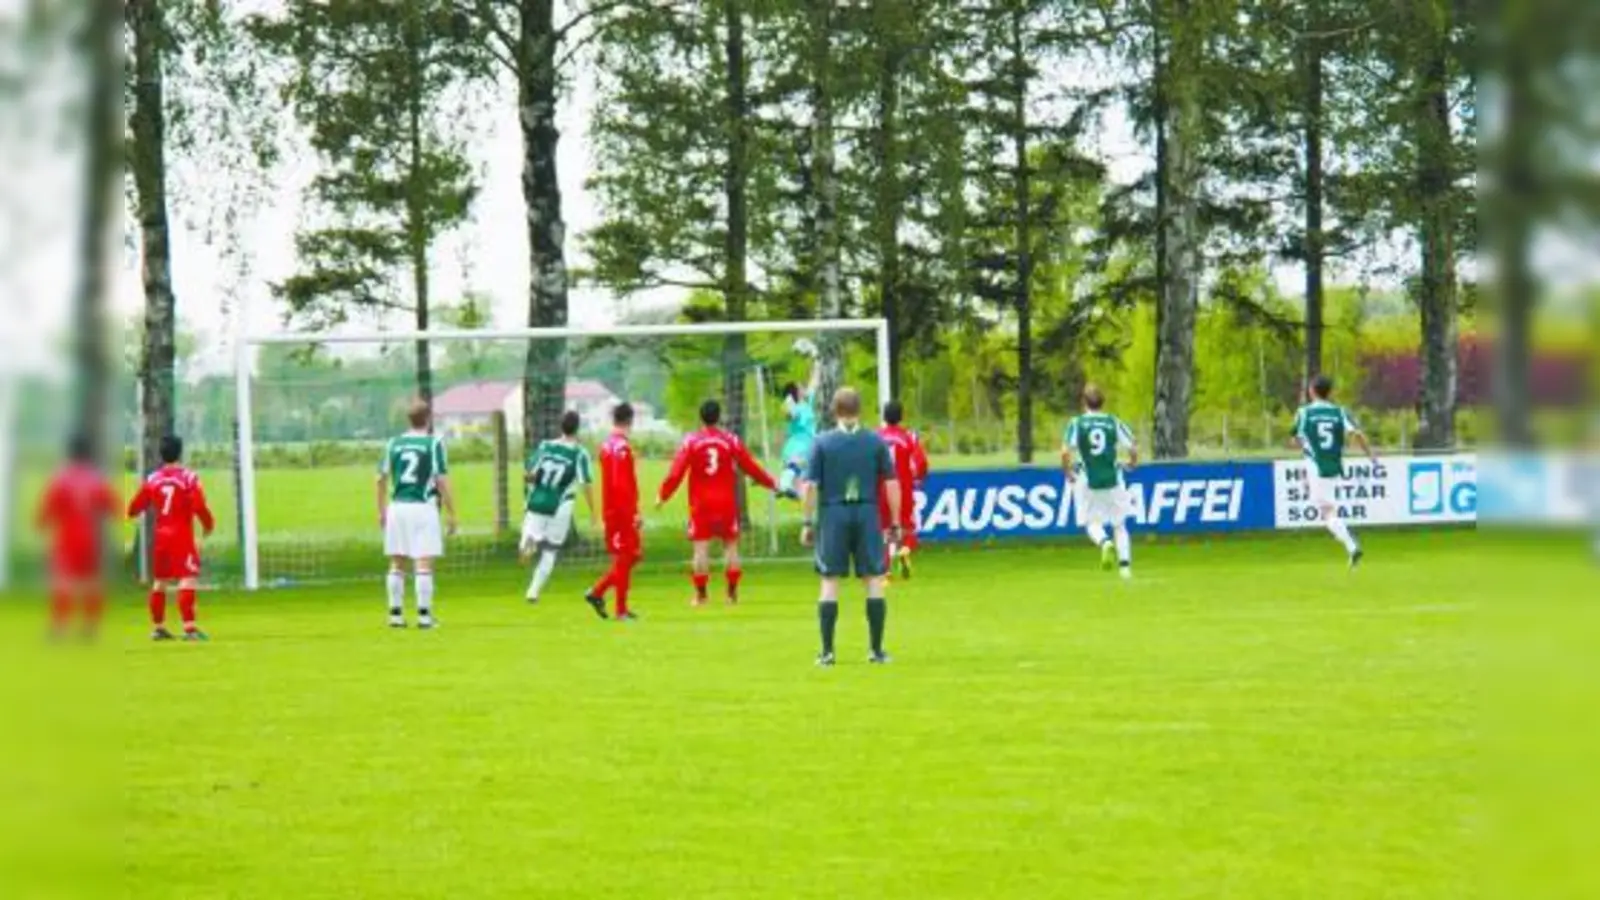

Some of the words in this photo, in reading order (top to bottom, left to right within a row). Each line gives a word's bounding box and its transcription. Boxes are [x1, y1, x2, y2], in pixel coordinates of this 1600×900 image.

[1089, 427, 1106, 455] 9
[1317, 421, 1334, 450] 5
[400, 451, 418, 484] 2
[704, 447, 718, 476] 3
[1286, 464, 1388, 481] HUNG
[161, 485, 175, 516] 7
